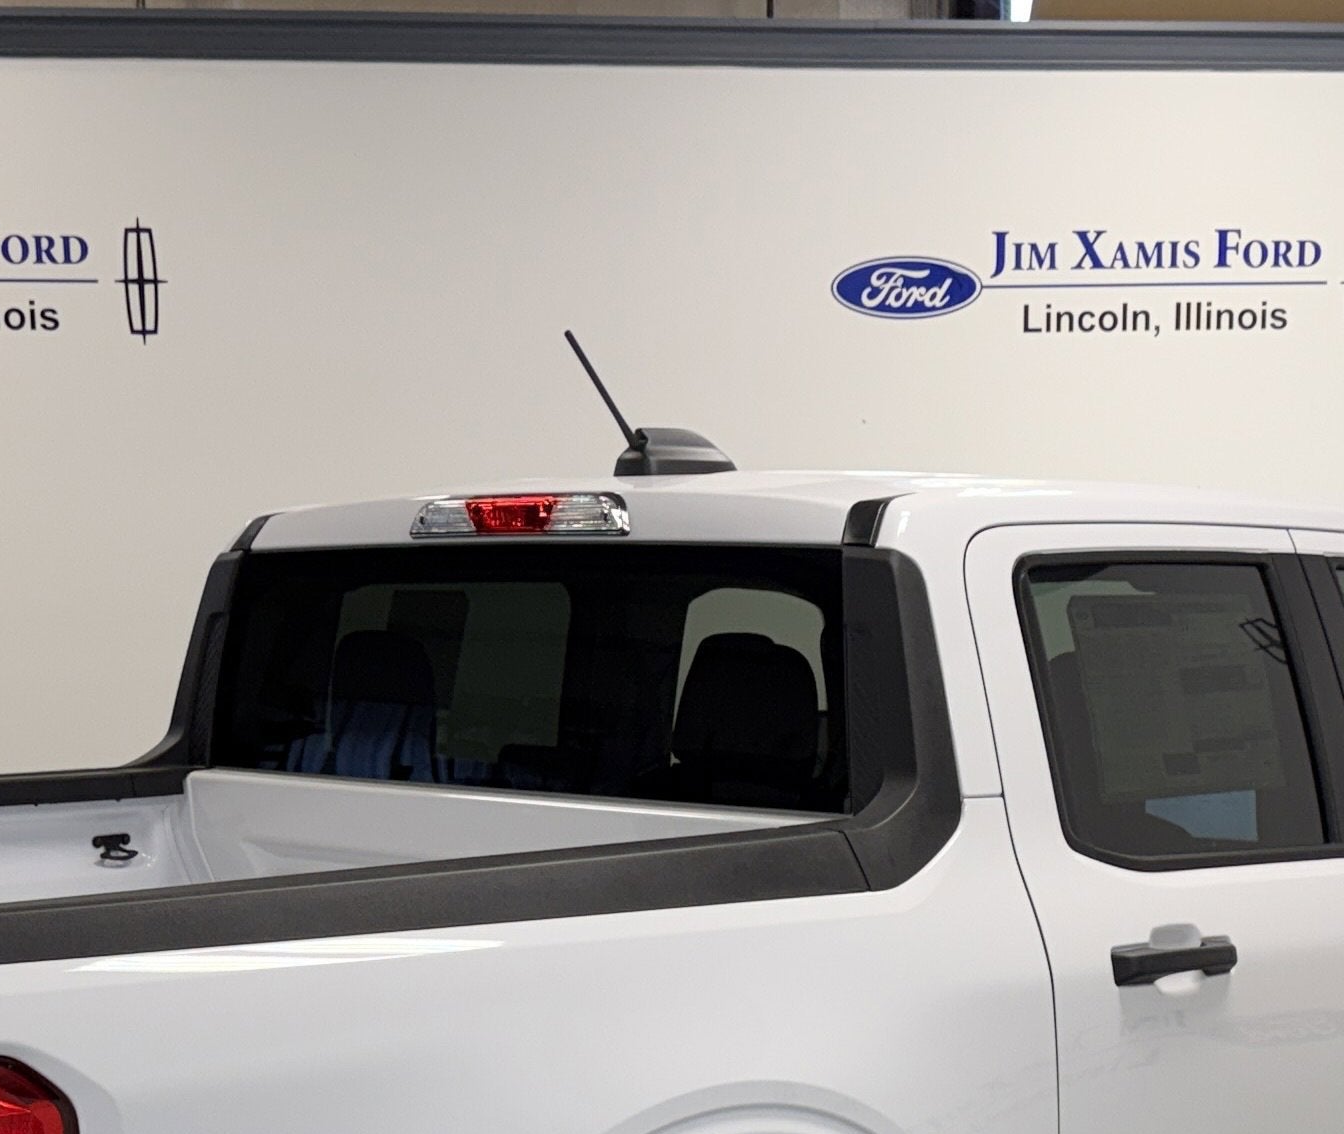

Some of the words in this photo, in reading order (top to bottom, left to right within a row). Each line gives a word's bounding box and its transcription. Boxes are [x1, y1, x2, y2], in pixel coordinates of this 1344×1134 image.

[1213, 228, 1322, 269] FORD
[860, 266, 951, 309] Ford
[1023, 303, 1160, 337] Lincoln,
[1174, 300, 1288, 332] Illinois
